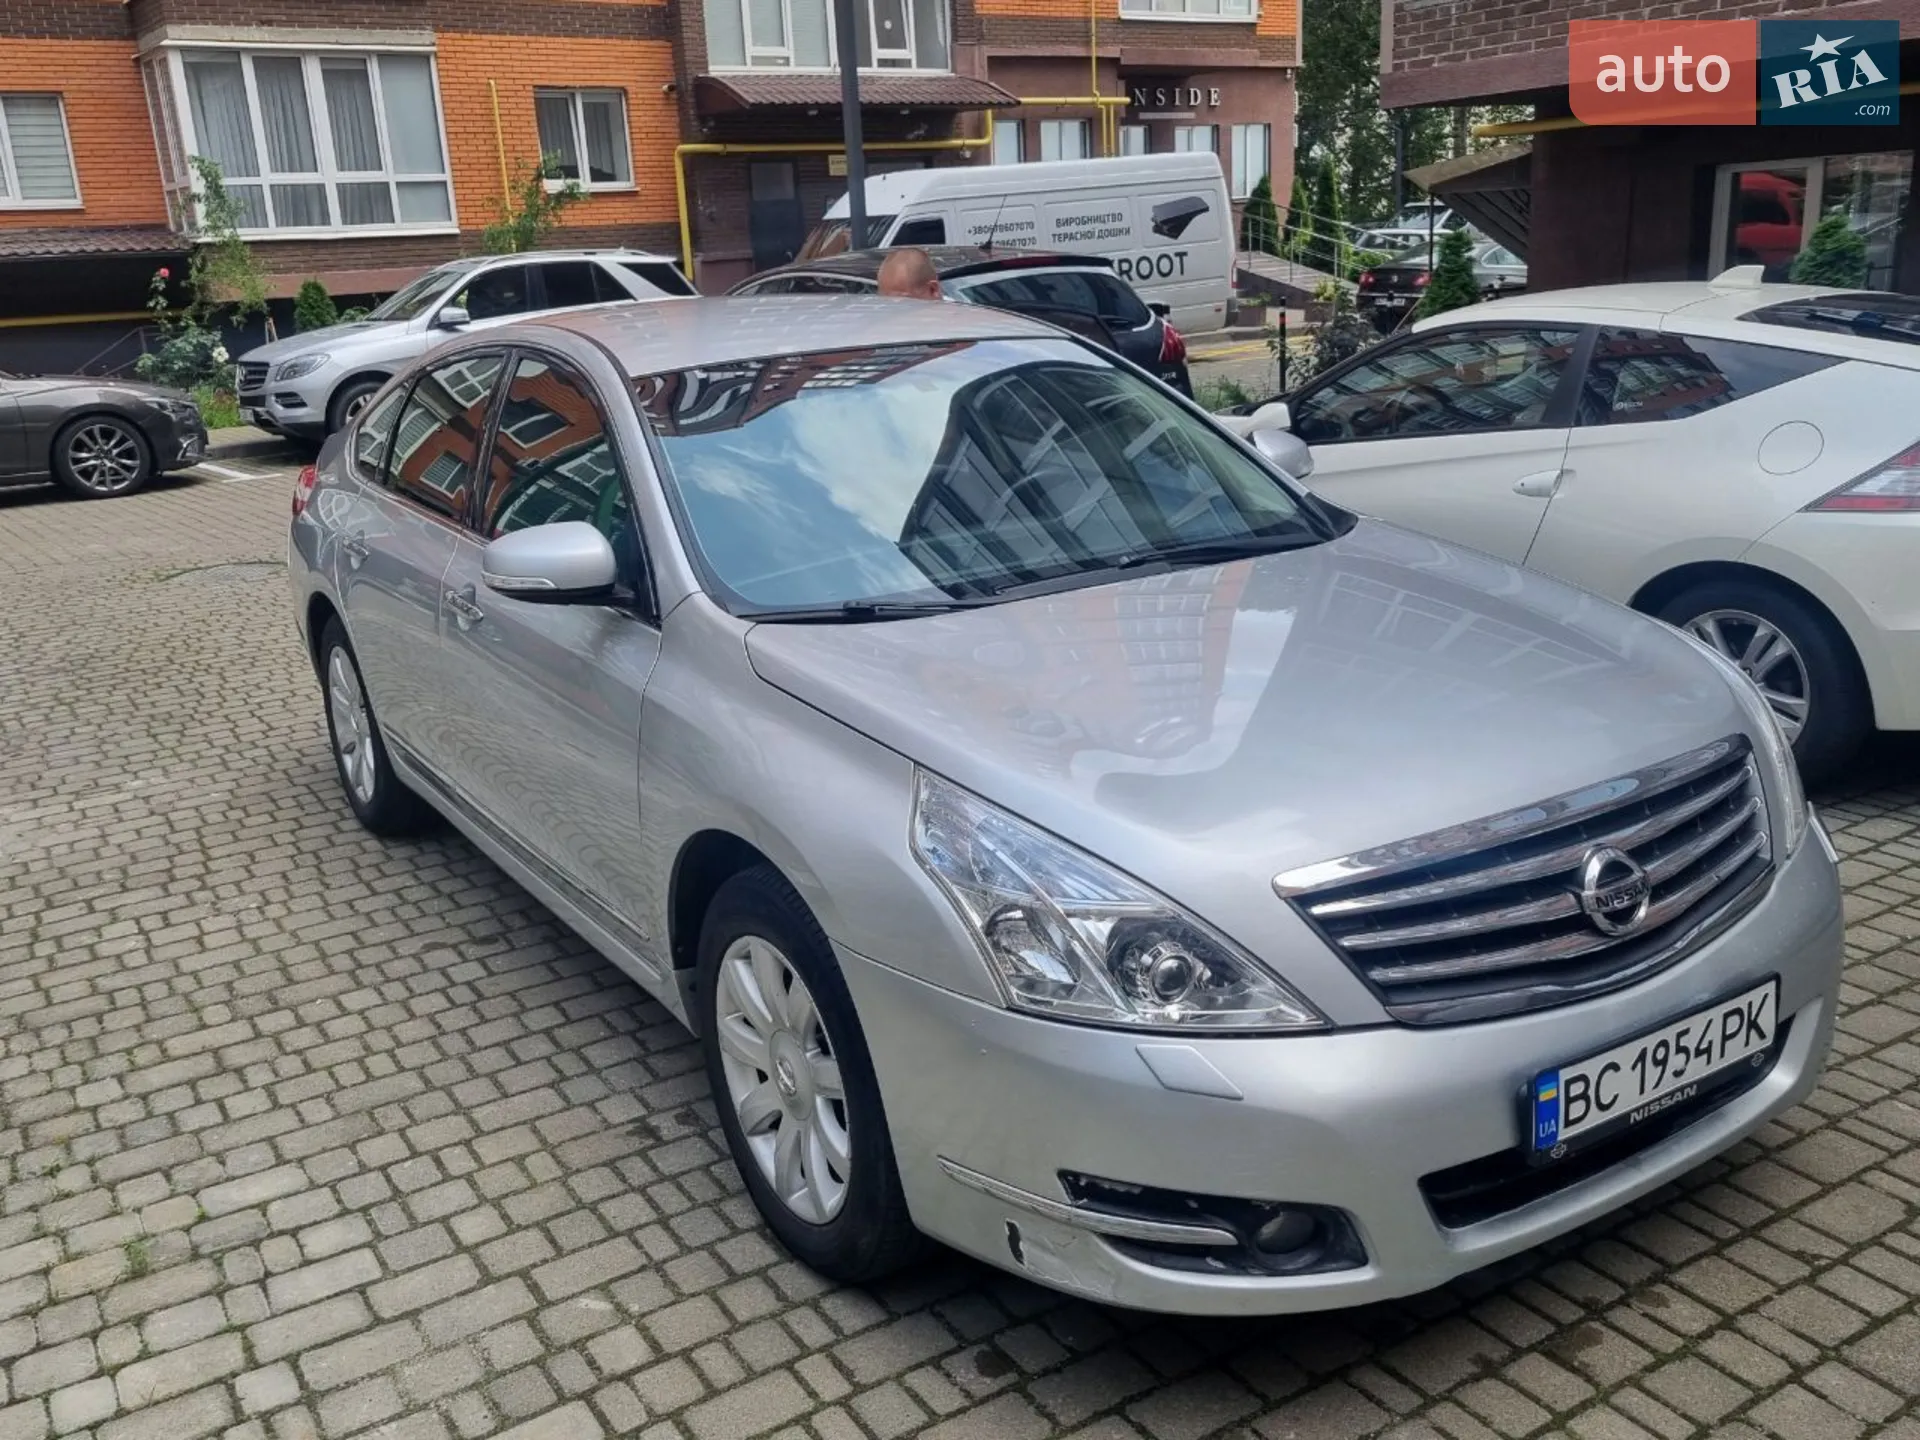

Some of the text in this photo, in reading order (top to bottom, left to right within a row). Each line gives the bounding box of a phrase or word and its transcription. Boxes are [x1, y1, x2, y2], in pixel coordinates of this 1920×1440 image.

[1055, 212, 1123, 228] ВИРОБНИЦТВО
[1051, 227, 1131, 243] ТЕРАСНОЇ ДОШКИ
[1563, 992, 1769, 1129] BC 1954 PK
[1629, 1084, 1698, 1124] NISSAN
[1539, 1121, 1557, 1138] UA
